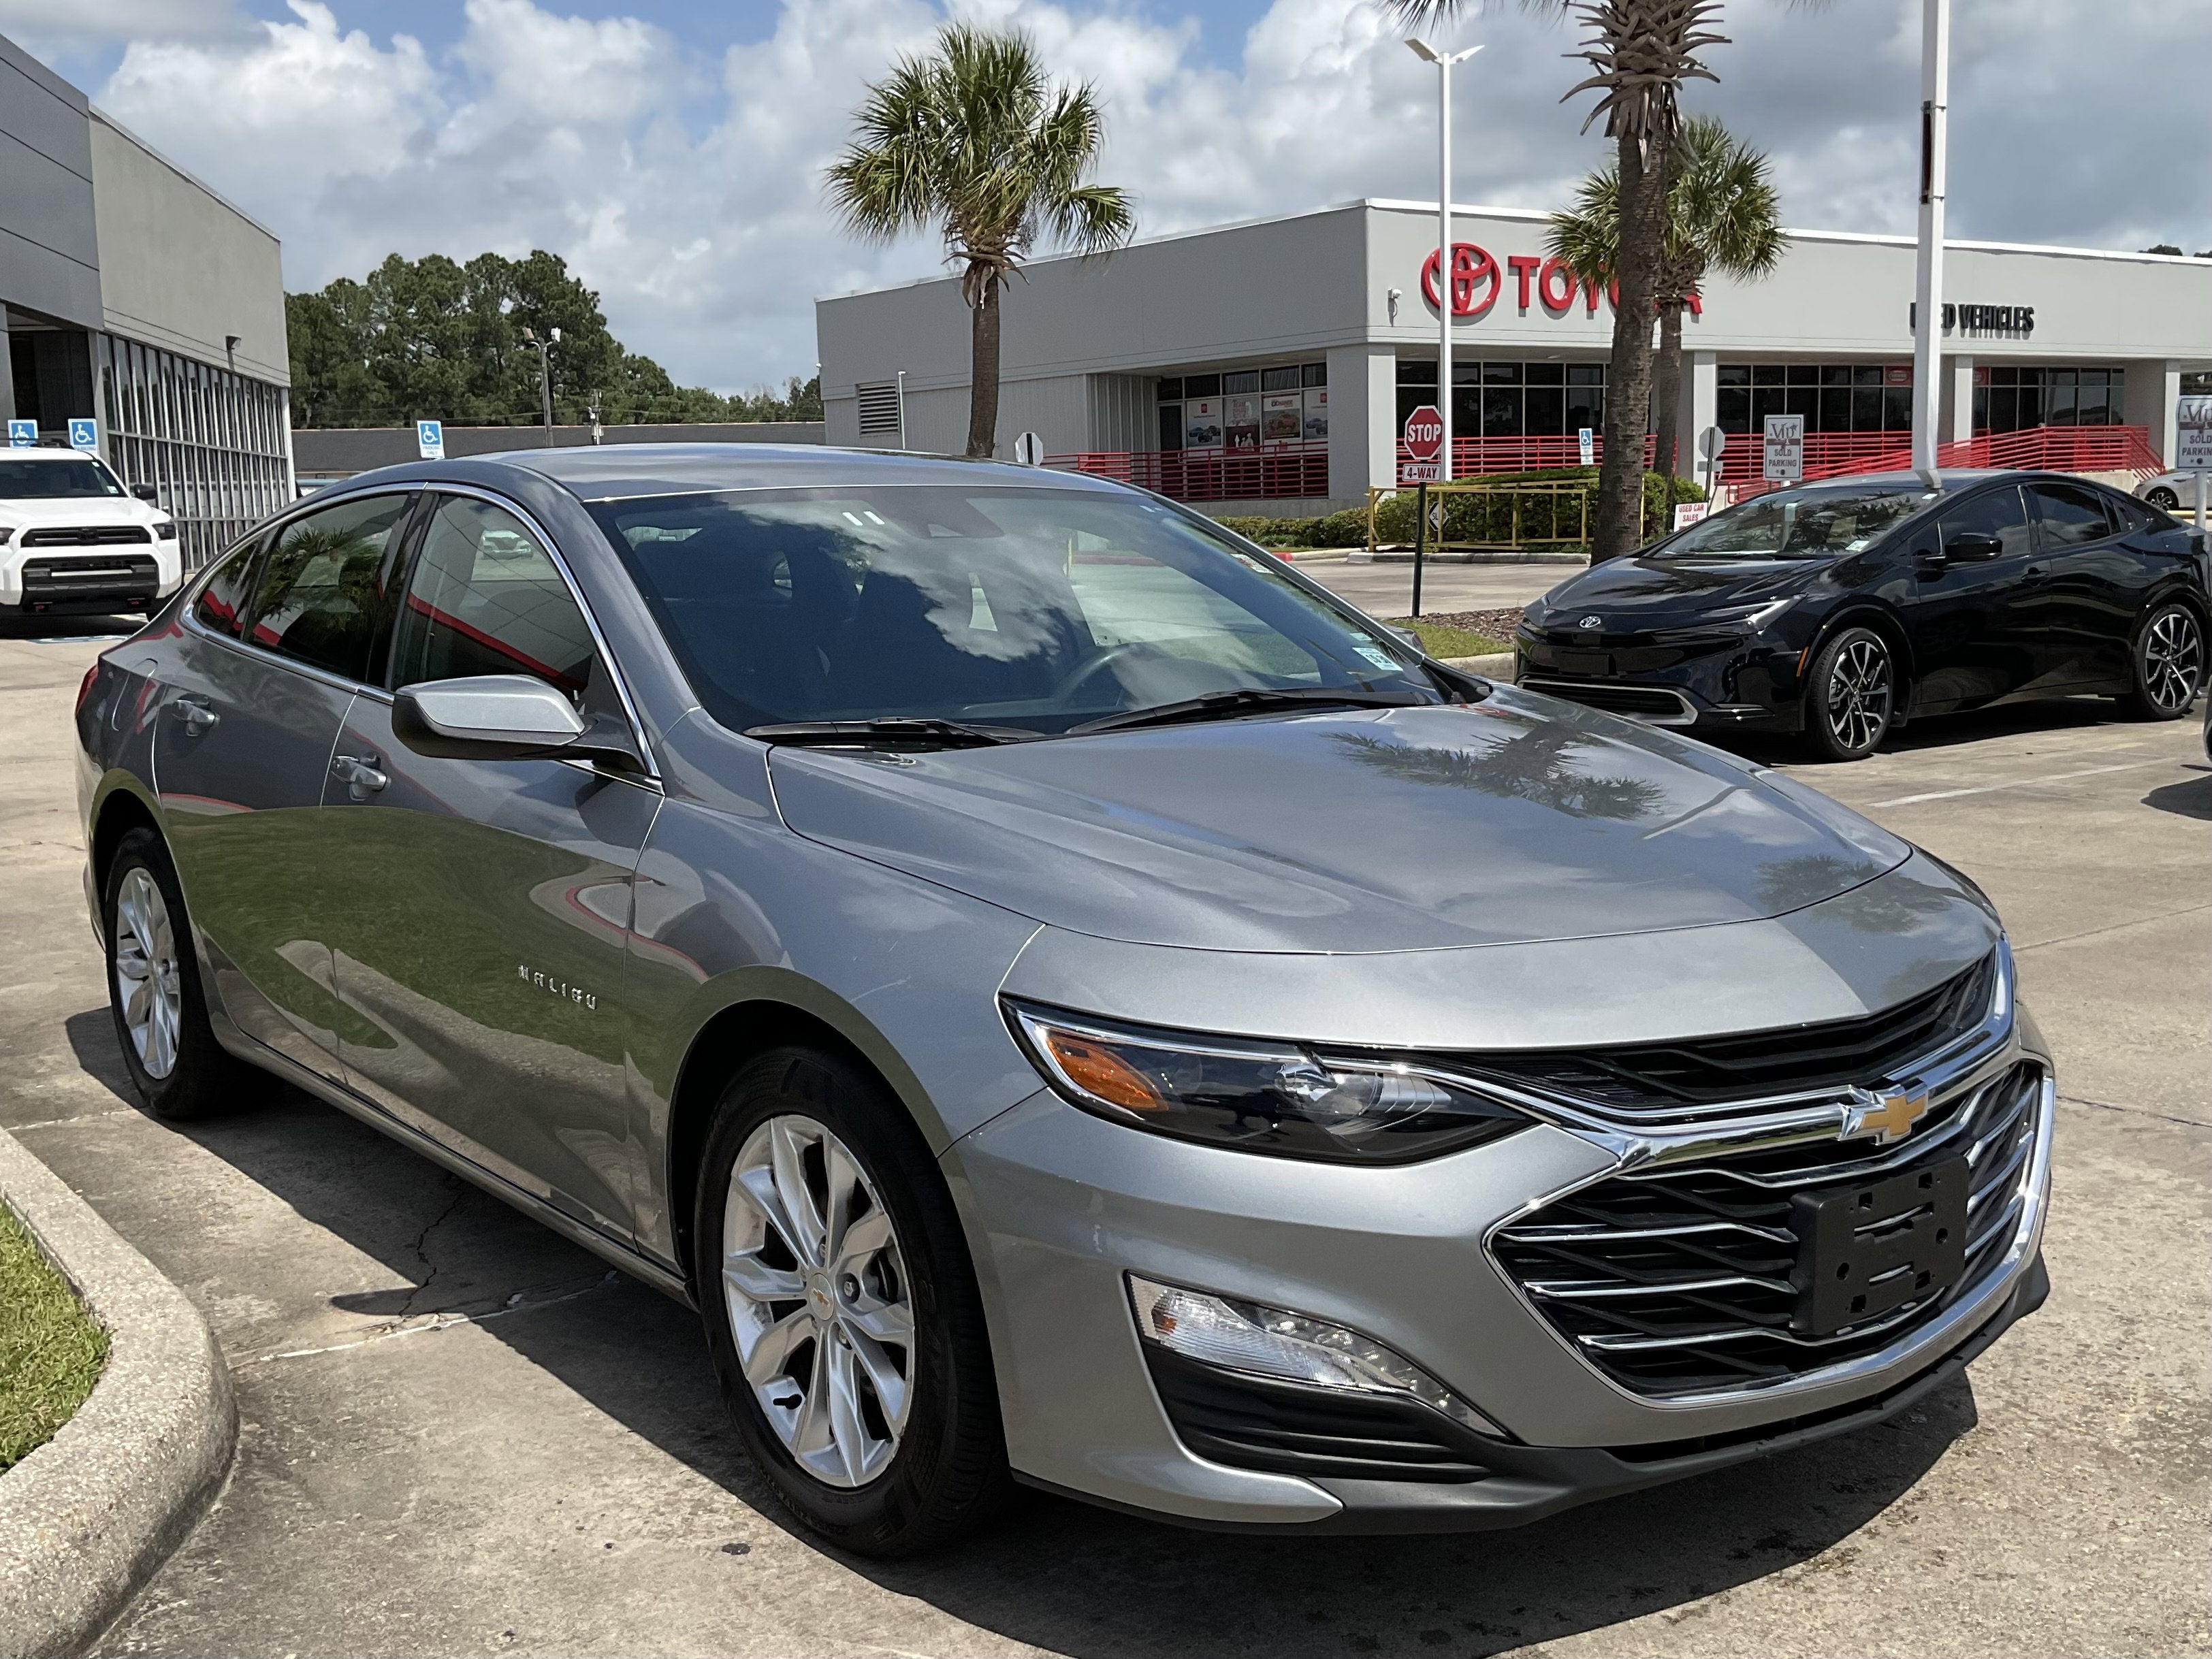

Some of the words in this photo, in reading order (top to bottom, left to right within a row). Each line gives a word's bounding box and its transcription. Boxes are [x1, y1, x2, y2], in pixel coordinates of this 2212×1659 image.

[1958, 304, 2034, 332] VEHICLES
[1407, 423, 1441, 442] STOP
[2189, 435, 2212, 445] SOLD
[1774, 449, 1792, 457] SOLD
[2181, 447, 2212, 456] PARKIN
[1768, 459, 1797, 467] PARKING
[1407, 467, 1437, 479] 4-WAY
[1679, 504, 1693, 513] USED
[1693, 504, 1704, 512] CAR
[1682, 514, 1699, 522] SALES
[518, 965, 596, 1010] MALIBU
